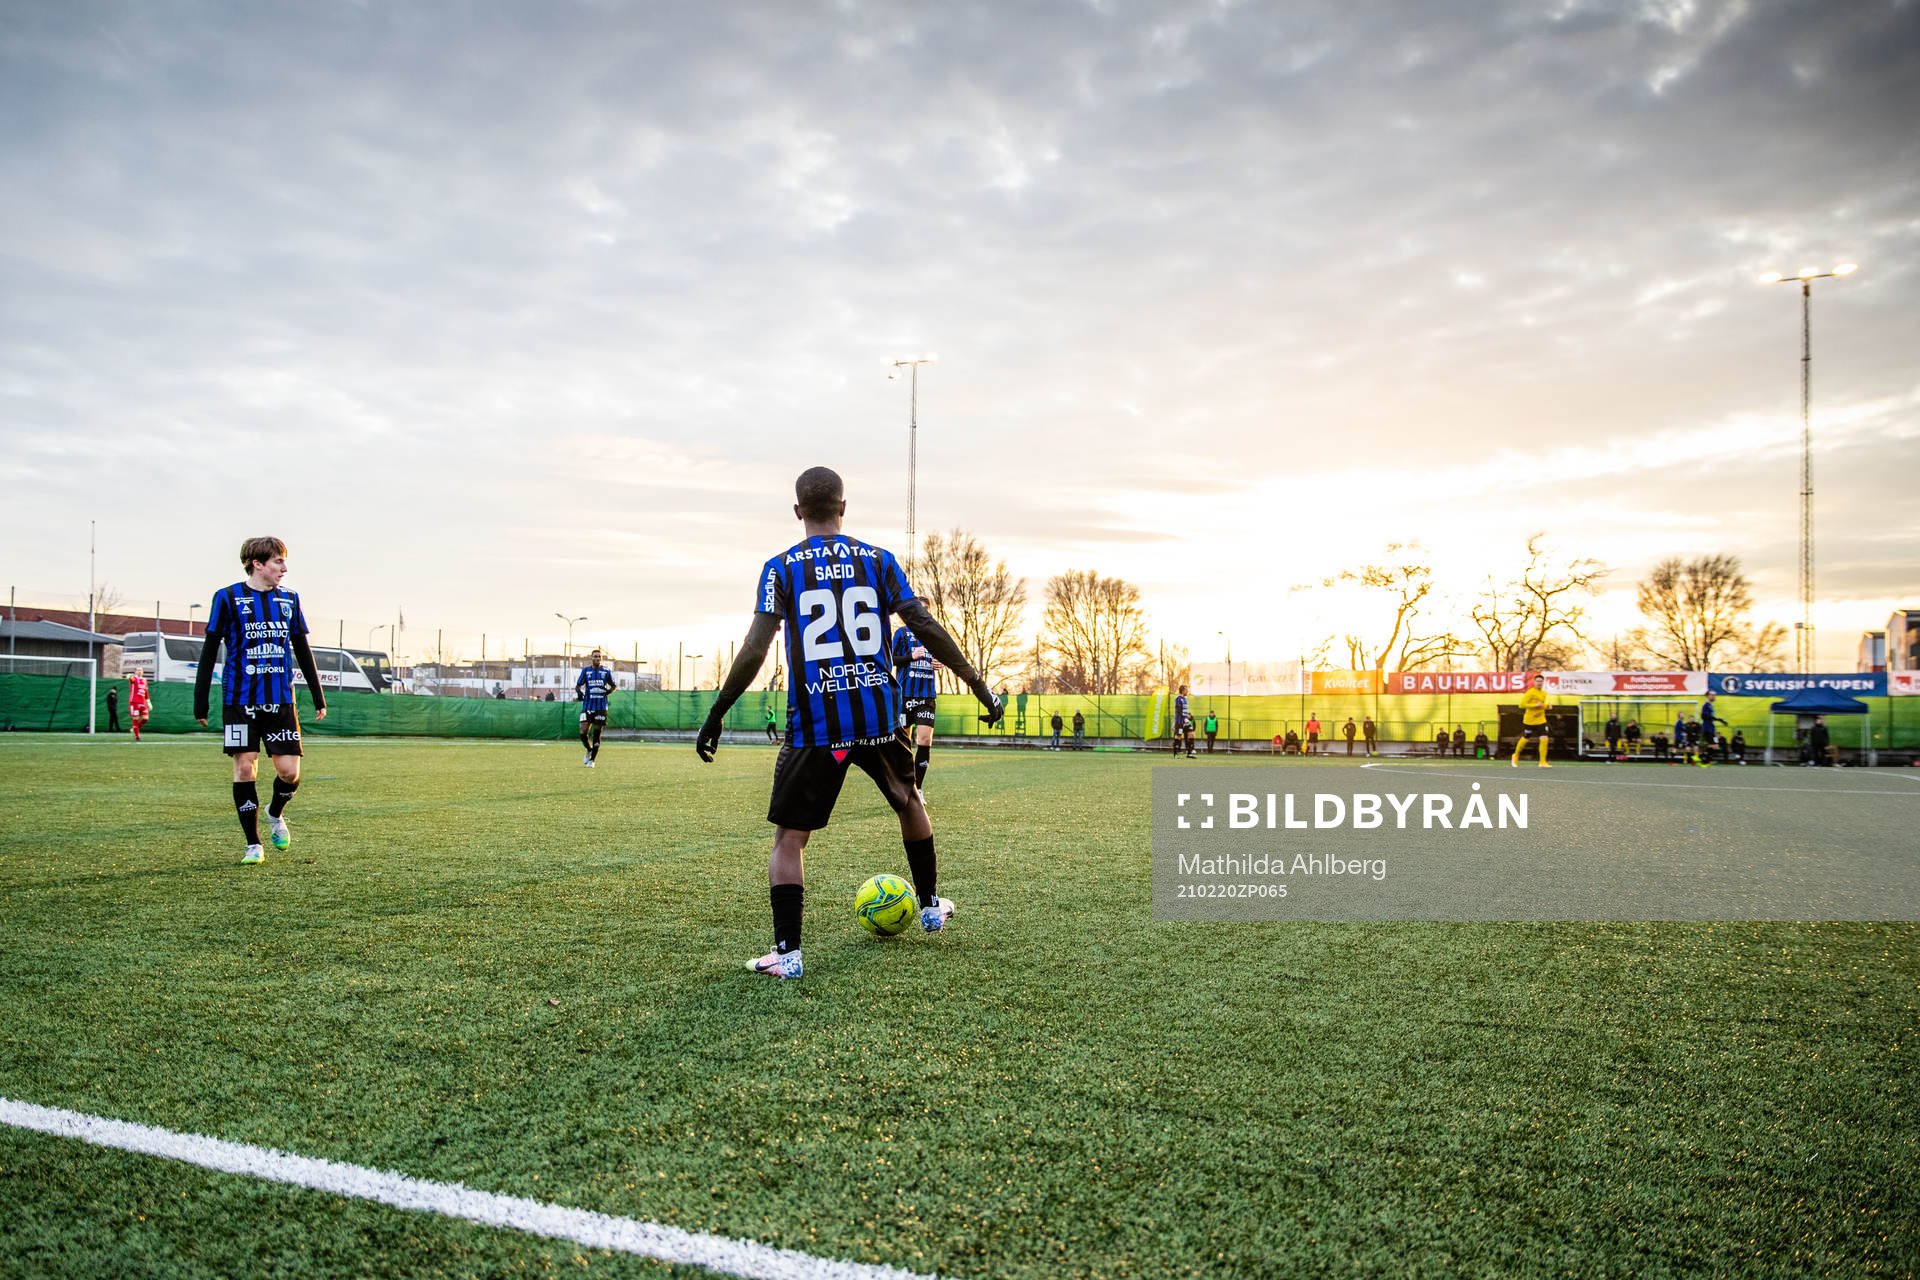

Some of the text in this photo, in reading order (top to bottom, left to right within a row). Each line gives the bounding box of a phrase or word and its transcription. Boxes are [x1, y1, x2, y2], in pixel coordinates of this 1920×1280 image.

[850, 546, 877, 558] TAK
[815, 564, 854, 581] SAEID
[764, 567, 777, 613] stadium
[245, 622, 267, 631] BYGG
[799, 586, 882, 662] 26
[805, 672, 889, 695] WELLNESS
[1403, 674, 1526, 690] BAUHAUS
